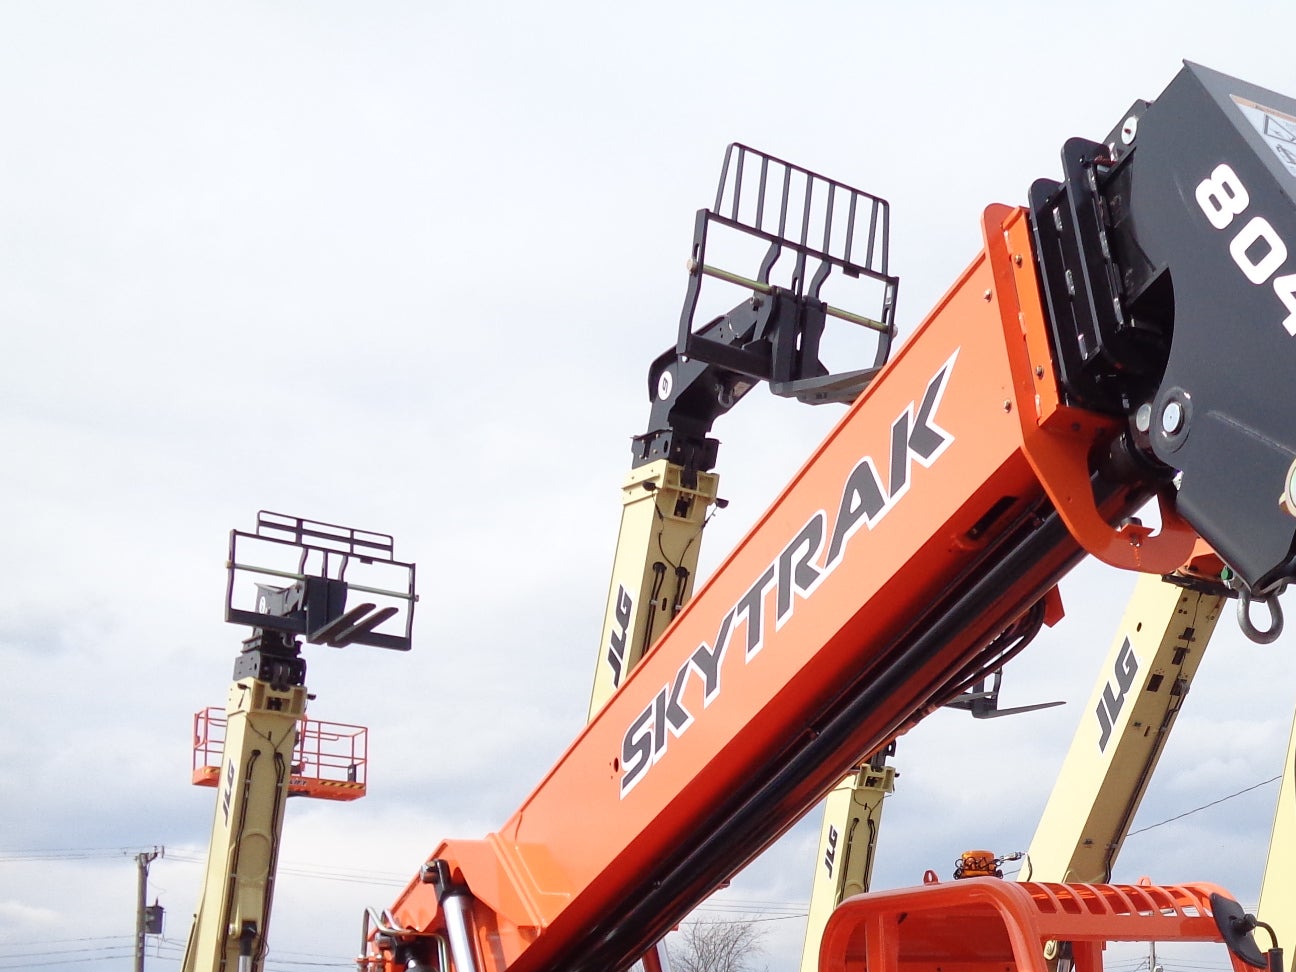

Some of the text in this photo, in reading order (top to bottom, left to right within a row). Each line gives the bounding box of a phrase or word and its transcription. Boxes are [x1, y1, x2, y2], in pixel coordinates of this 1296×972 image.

[619, 345, 961, 801] SKYTRAK
[606, 582, 634, 690] JLG
[1095, 634, 1139, 755] JLG
[222, 756, 235, 828] JLG
[824, 823, 838, 880] JLG
